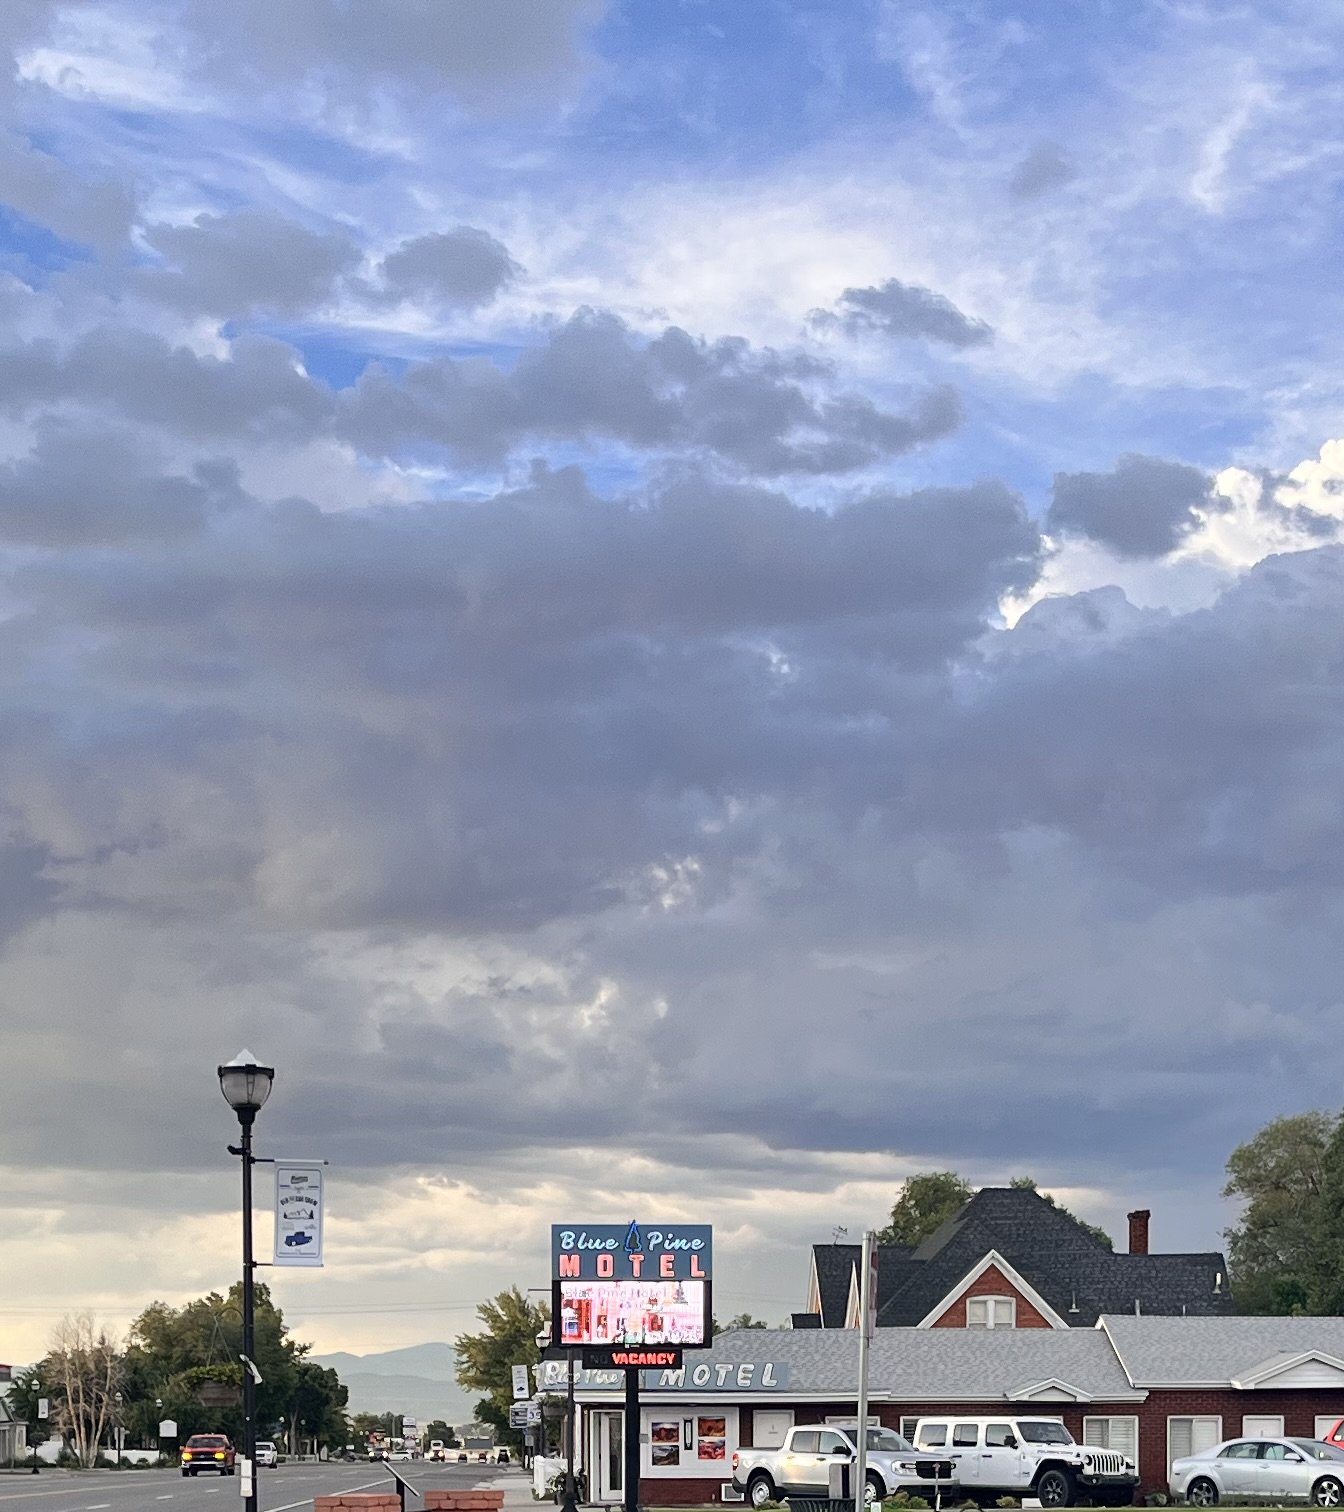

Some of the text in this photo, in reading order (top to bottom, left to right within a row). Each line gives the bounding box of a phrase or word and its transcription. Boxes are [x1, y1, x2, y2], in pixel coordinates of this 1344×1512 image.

[559, 1230, 705, 1251] Blue Pine
[559, 1254, 706, 1278] MOTEL
[611, 1352, 676, 1365] VACANCY
[544, 1362, 581, 1385] Ble
[659, 1362, 778, 1388] MOTEL
